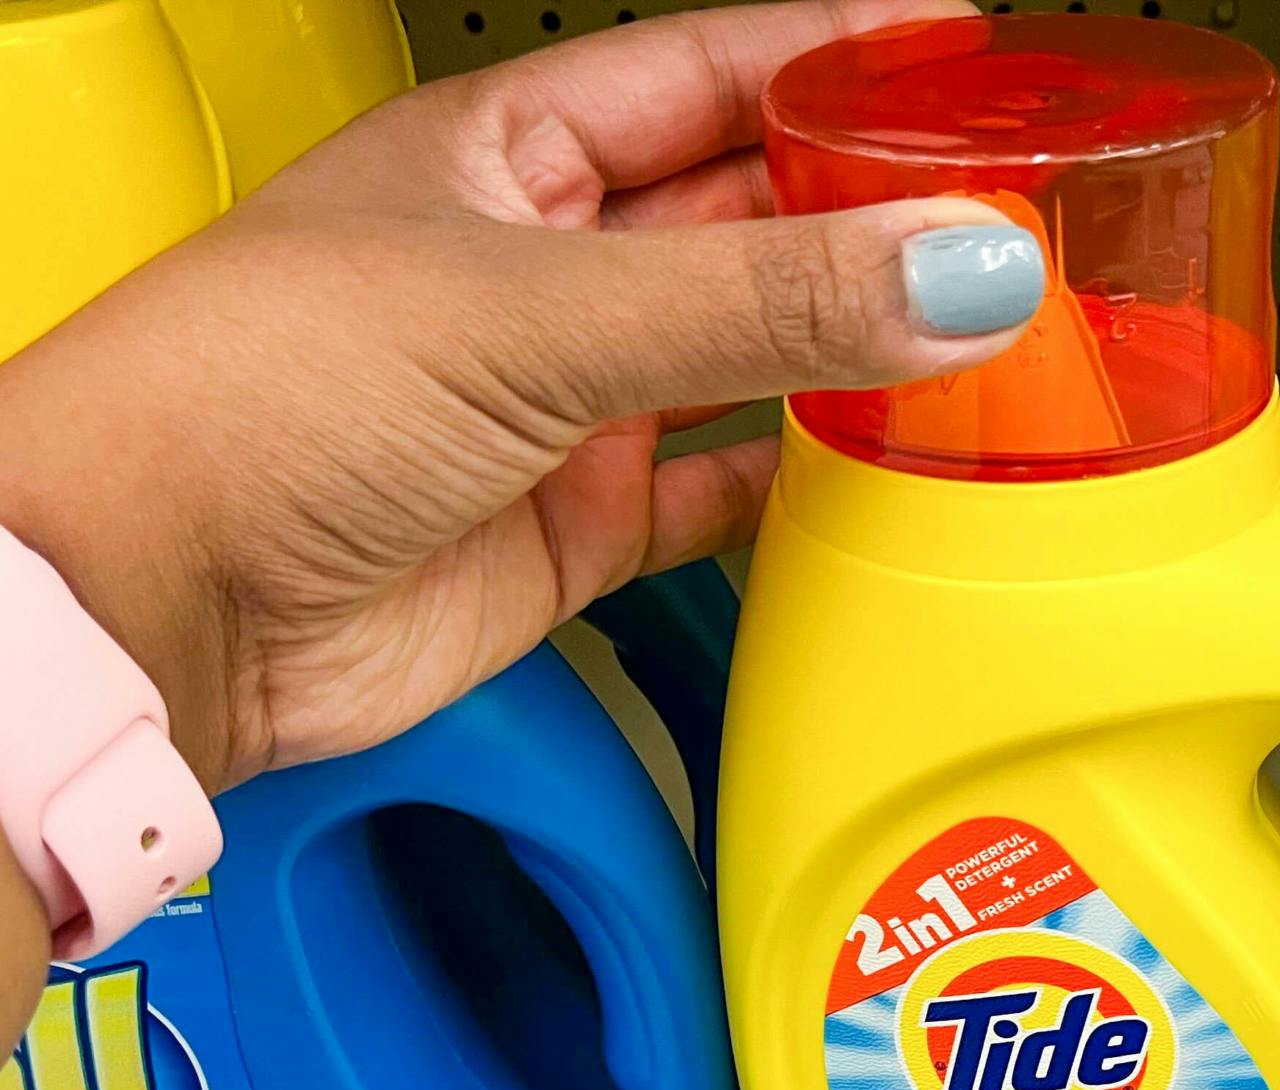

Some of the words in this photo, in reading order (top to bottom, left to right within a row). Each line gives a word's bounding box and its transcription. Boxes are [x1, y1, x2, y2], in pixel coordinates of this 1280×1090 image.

[945, 833, 1028, 879] POWERFUL
[955, 840, 1040, 891] DETERGENT
[977, 891, 1025, 922] FRESH
[1024, 865, 1073, 897] SCENT
[845, 873, 978, 976] 2in1
